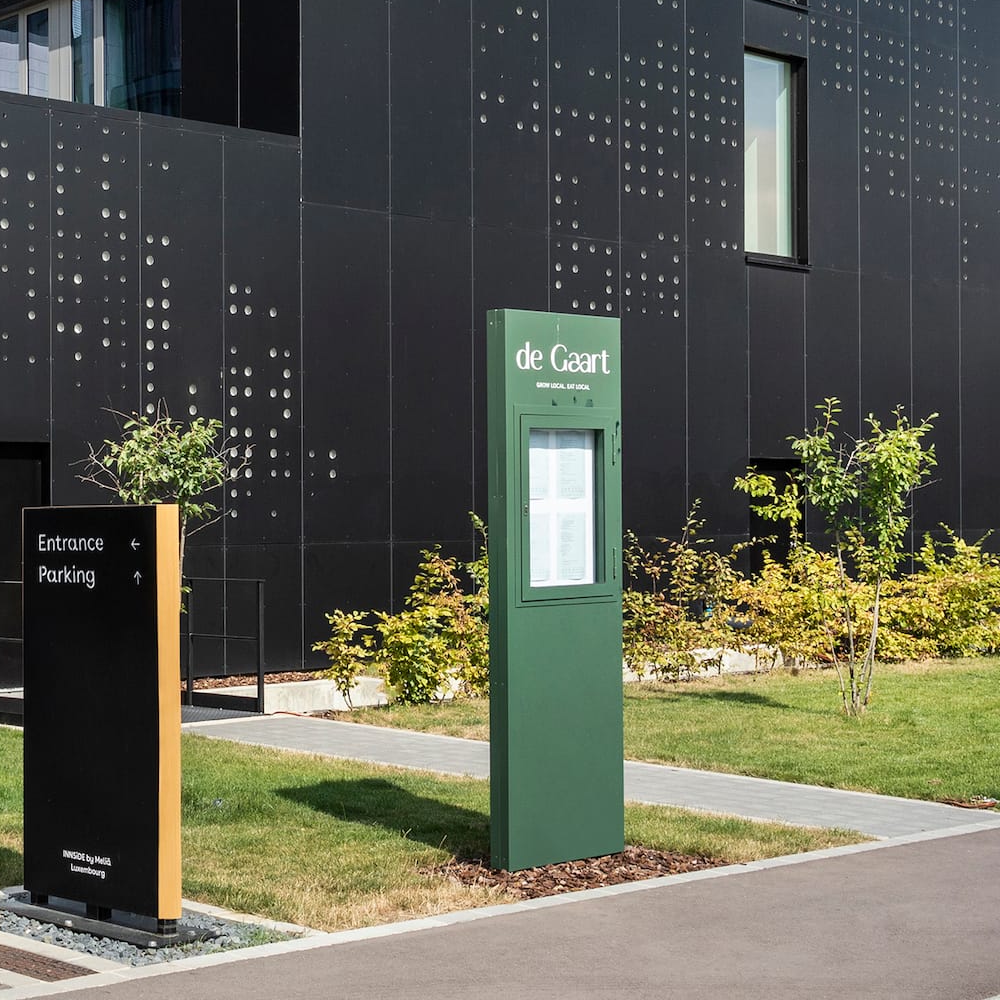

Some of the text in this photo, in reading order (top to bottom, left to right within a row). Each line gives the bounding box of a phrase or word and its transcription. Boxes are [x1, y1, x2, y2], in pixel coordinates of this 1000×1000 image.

[516, 341, 611, 374] de Gaart
[576, 383, 590, 391] LOCAL
[38, 534, 104, 551] Entrance
[38, 565, 95, 589] Parking
[86, 854, 94, 864] by
[71, 863, 105, 879] Luxembourg
